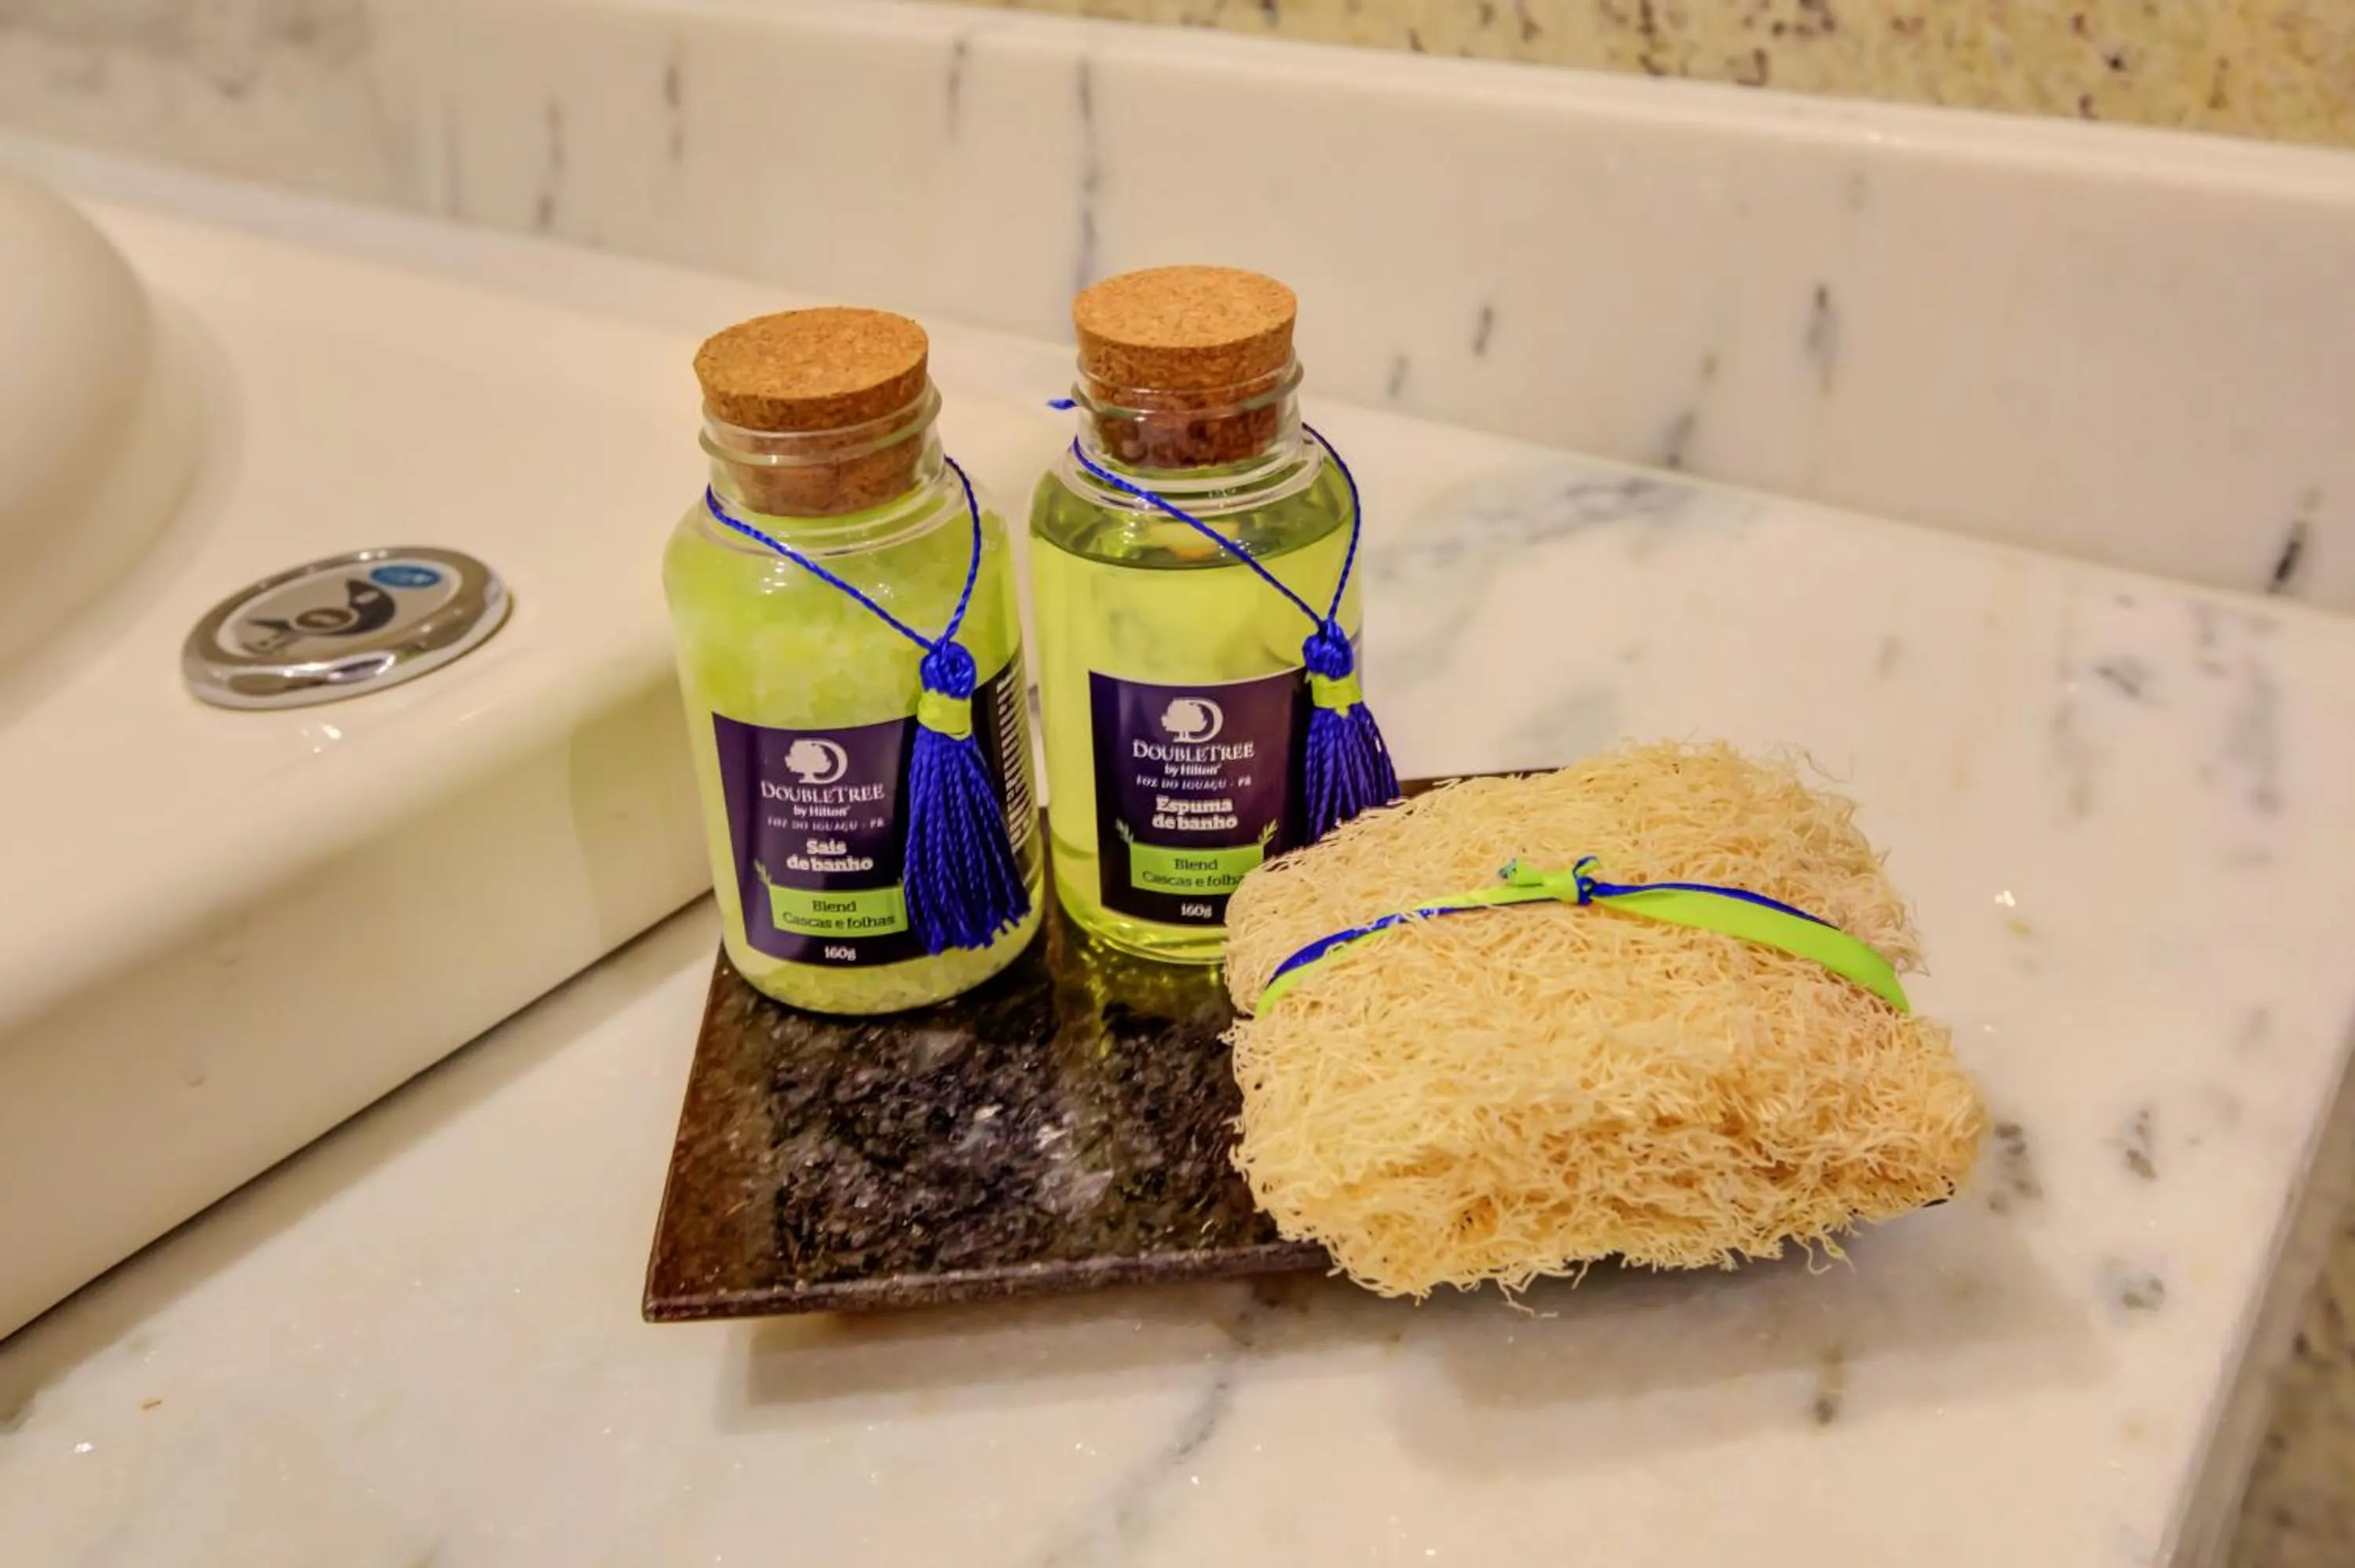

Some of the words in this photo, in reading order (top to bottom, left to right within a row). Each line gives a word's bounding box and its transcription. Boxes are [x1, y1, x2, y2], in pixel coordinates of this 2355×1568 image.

[1164, 763, 1178, 777] by
[1180, 763, 1218, 776] Hilton
[1161, 778, 1178, 789] DO
[793, 804, 807, 818] by
[809, 805, 849, 817] Hilton
[1156, 794, 1233, 815] Espuma
[791, 820, 809, 830] DO
[1152, 813, 1176, 830] de
[1177, 814, 1239, 831] banho
[805, 839, 848, 855] Sais
[786, 854, 810, 870] de
[810, 856, 874, 872] banho
[1174, 858, 1219, 871] Blend
[1142, 871, 1192, 887] Cascas
[1195, 877, 1205, 888] e
[1207, 873, 1243, 888] folha
[812, 899, 857, 913] Blend
[1181, 903, 1213, 919] 160g
[783, 911, 832, 929] Cascas
[834, 919, 845, 930] e
[847, 914, 896, 930] folhas
[824, 945, 857, 962] 160g
